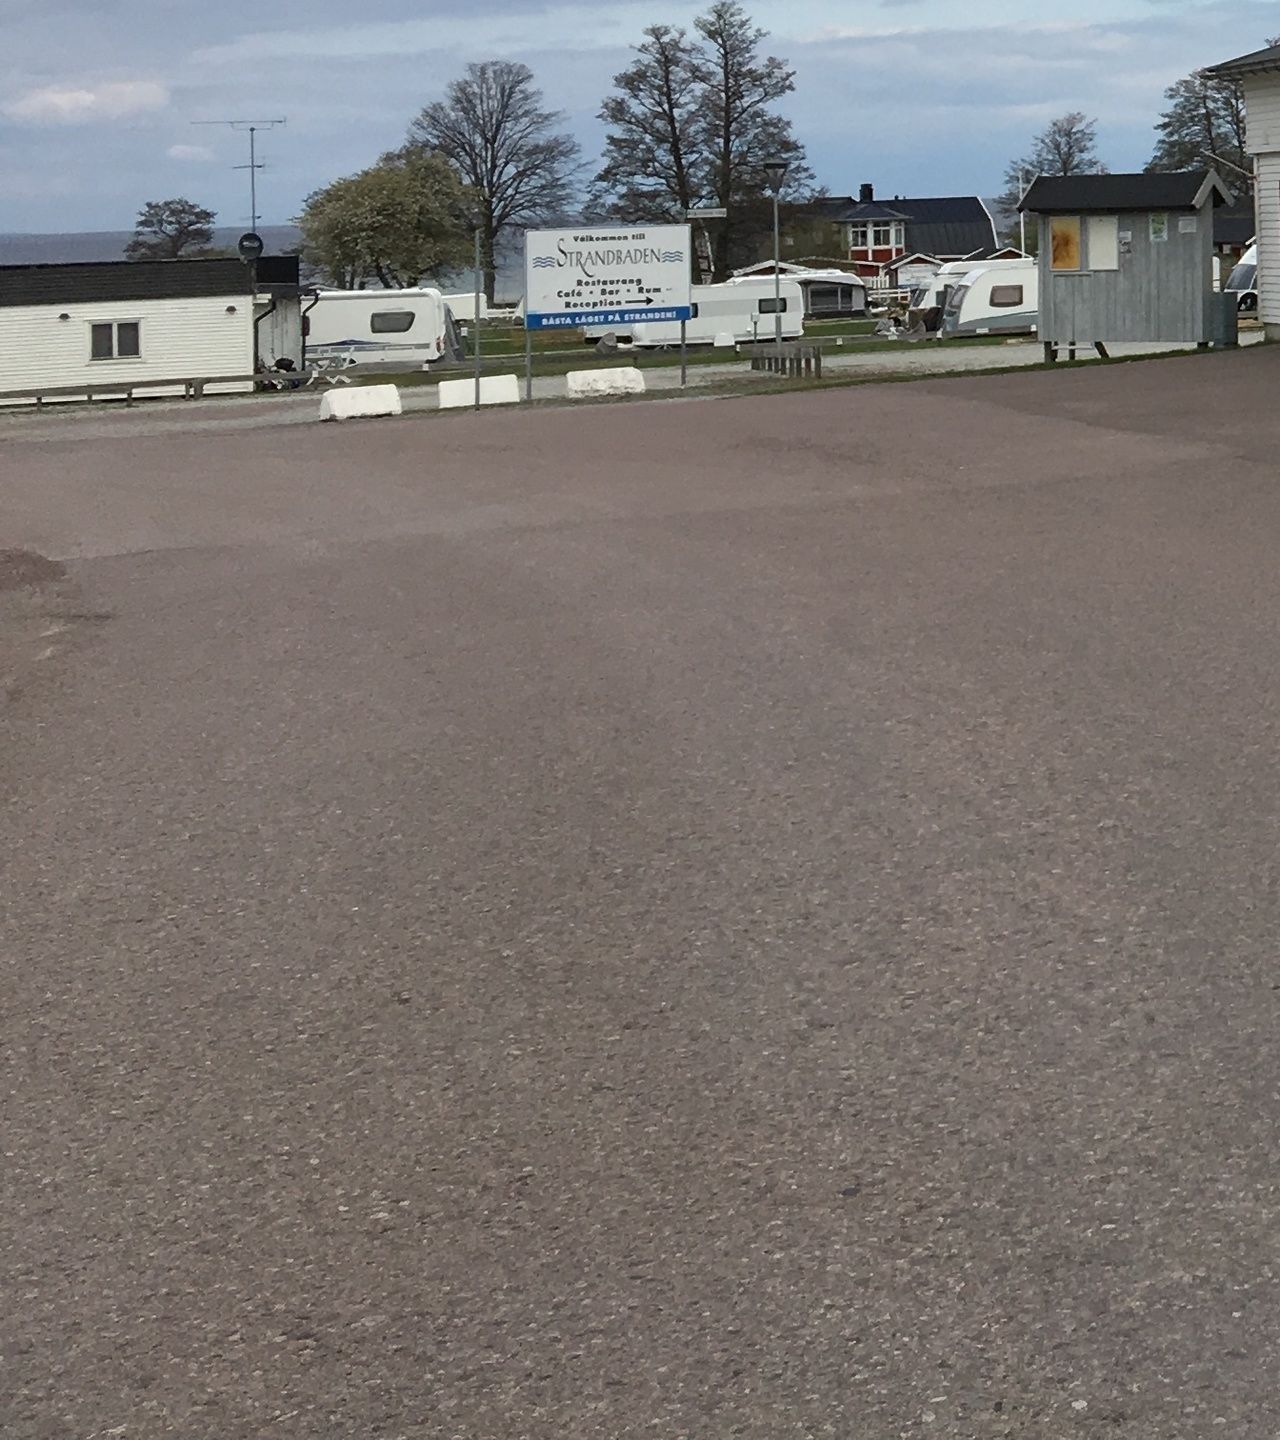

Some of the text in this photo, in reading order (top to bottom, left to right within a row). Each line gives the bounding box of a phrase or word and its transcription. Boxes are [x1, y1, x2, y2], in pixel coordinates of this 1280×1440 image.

[631, 233, 646, 241] till
[576, 278, 642, 287] Restaurang
[600, 288, 620, 296] Bar
[564, 299, 622, 309] Reception
